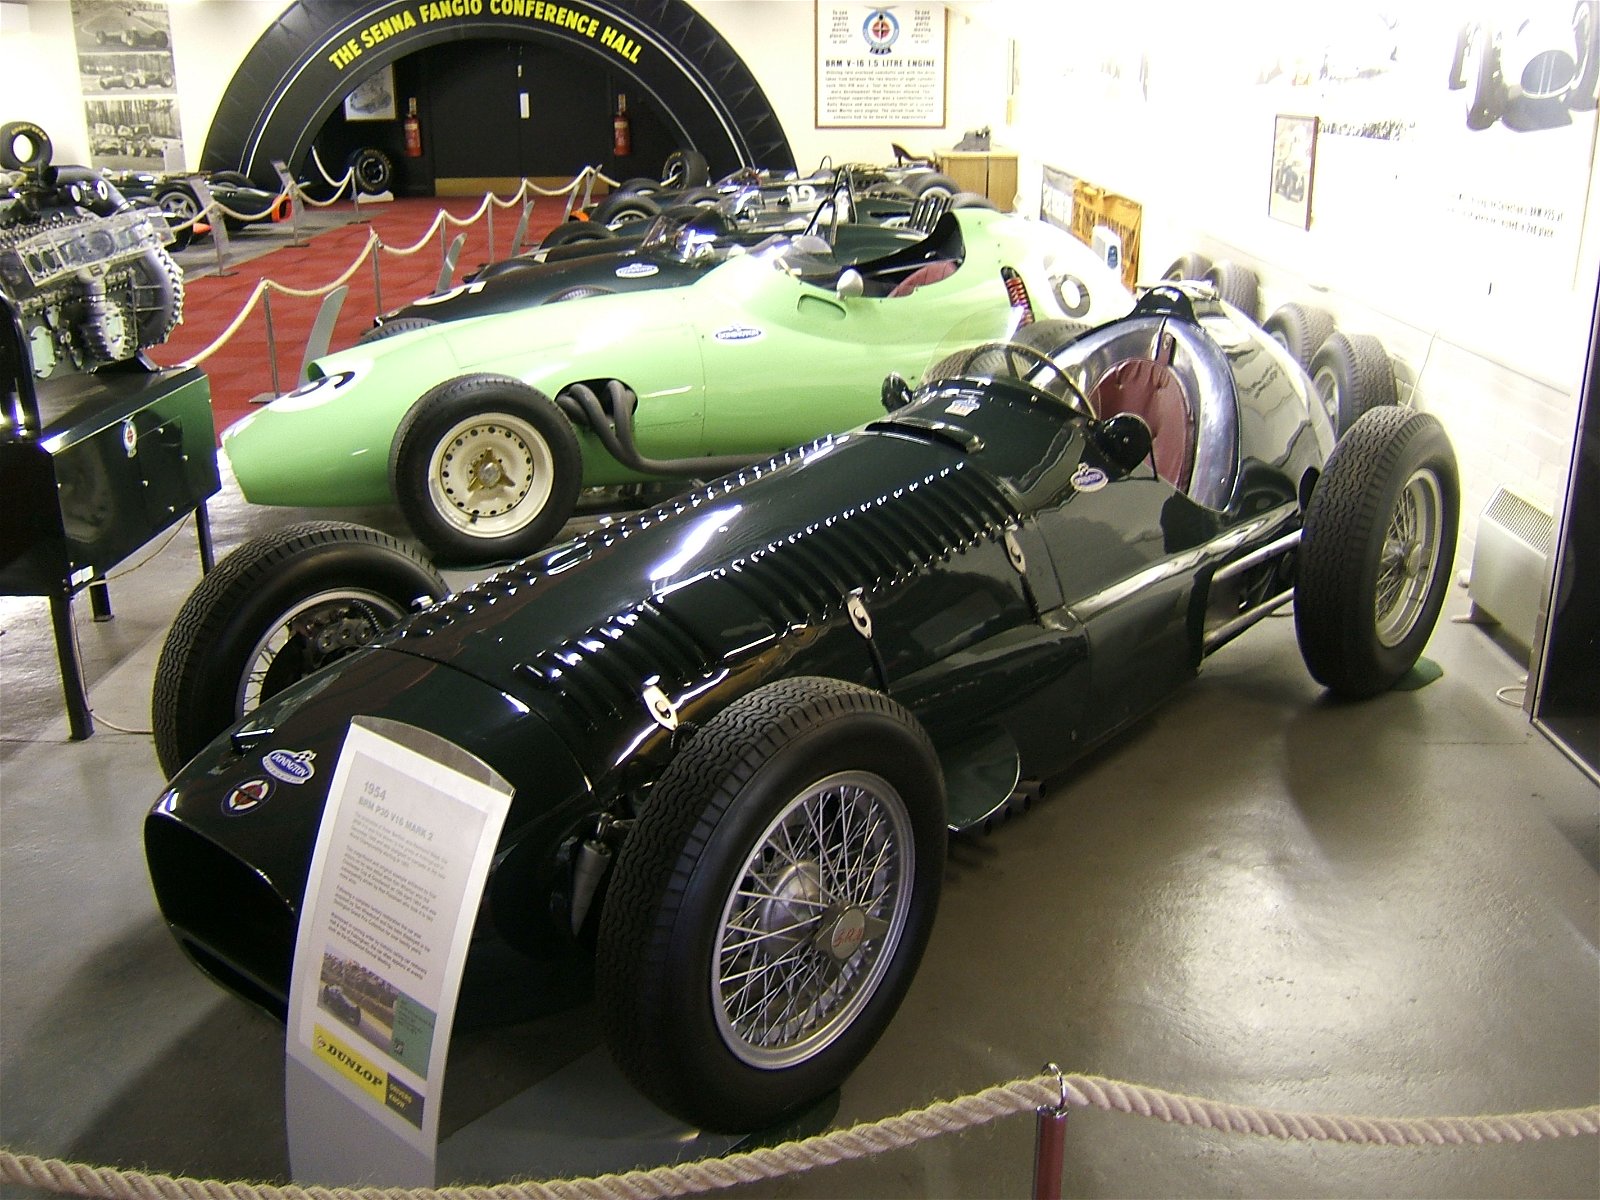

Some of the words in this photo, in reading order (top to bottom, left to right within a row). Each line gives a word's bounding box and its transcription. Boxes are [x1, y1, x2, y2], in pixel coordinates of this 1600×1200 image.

[329, 38, 363, 70] THE
[360, 10, 417, 49] SENNA
[419, 0, 483, 23] FANGIO
[490, 0, 600, 38] CONFERENCE
[600, 26, 642, 64] HALL
[825, 59, 843, 67] BRM
[846, 59, 865, 67] V-16
[882, 59, 903, 67] LITRE
[907, 59, 935, 67] ENGINE
[363, 781, 387, 801] 1954
[405, 820, 429, 838] MARK
[428, 832, 434, 841] 2
[327, 1044, 383, 1087] DUNLOP
